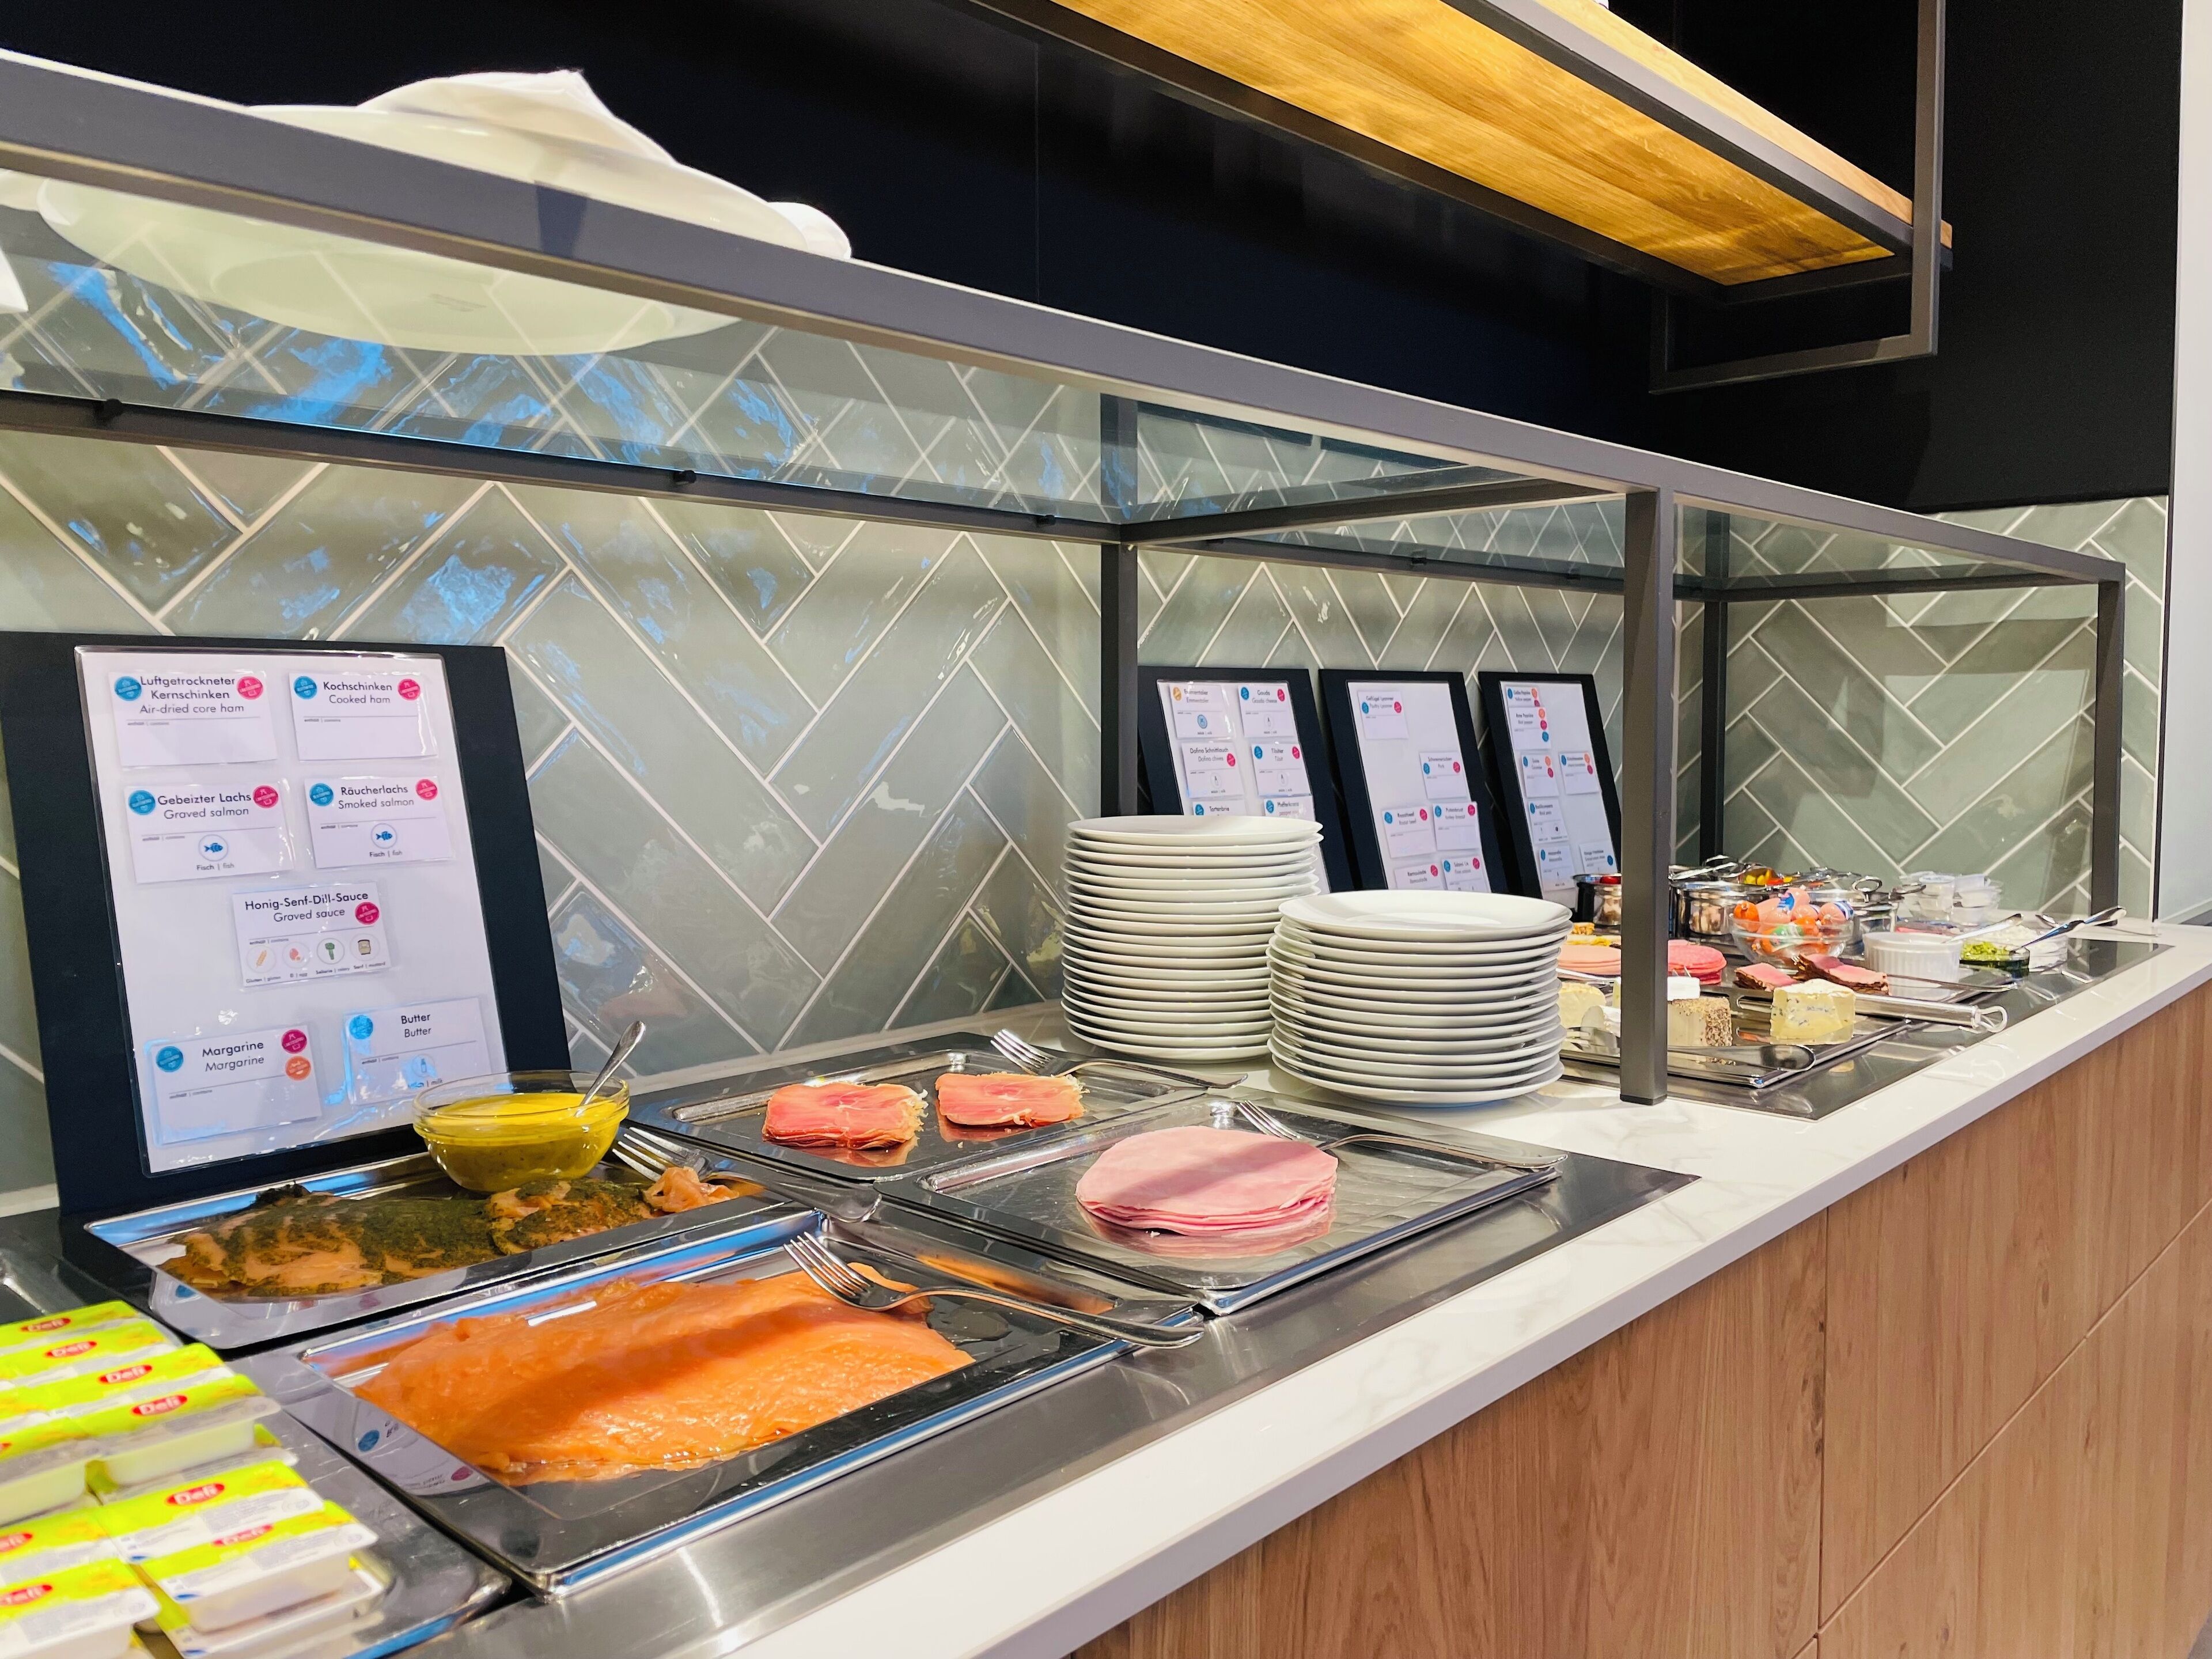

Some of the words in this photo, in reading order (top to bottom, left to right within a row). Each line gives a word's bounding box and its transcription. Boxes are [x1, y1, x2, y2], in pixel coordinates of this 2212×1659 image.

[140, 676, 235, 687] Luftgetrockneter
[323, 681, 392, 691] Kochschinken
[150, 690, 230, 699] Kernschinken
[328, 695, 366, 704] Cooked
[370, 695, 391, 703] ham
[139, 704, 189, 714] Air-dried
[193, 705, 217, 713] core
[220, 703, 244, 713] ham
[341, 785, 408, 796] Räucherlachs
[157, 794, 215, 805] Gebeizter
[219, 792, 251, 802] Lachs
[338, 800, 377, 809] Smoked
[381, 797, 414, 807] salmon
[164, 808, 206, 819] Graved
[210, 807, 249, 817] salmon
[245, 893, 369, 911] Honig-Senf-Dill-Sauce
[273, 910, 312, 922] Graved
[316, 908, 345, 918] sauce
[401, 1014, 431, 1025] Butter
[404, 1027, 431, 1038] Butter
[202, 1041, 264, 1058] Margarine
[205, 1055, 265, 1072] Margarine
[105, 1366, 145, 1384] Deli
[138, 1396, 179, 1415] Deli
[173, 1484, 218, 1504] Deli
